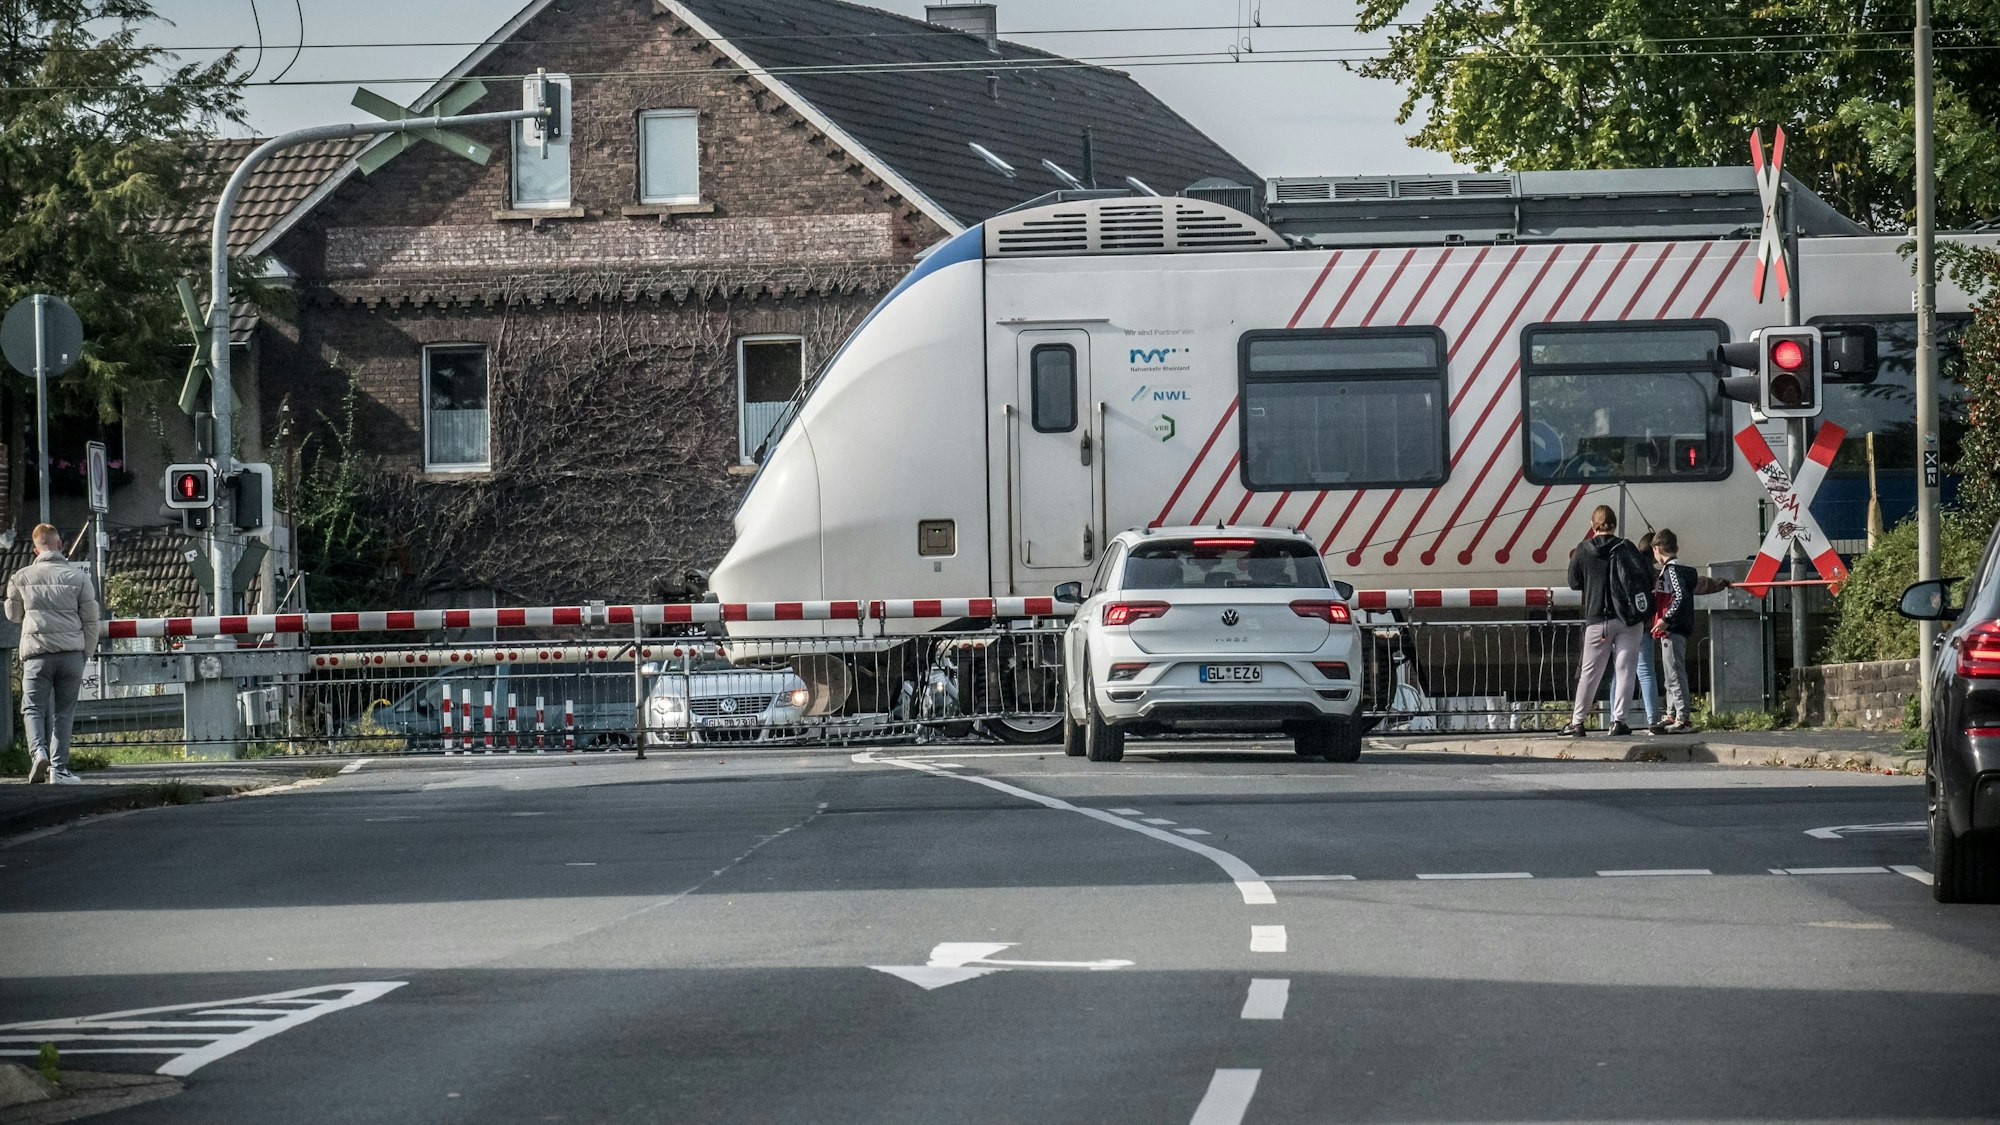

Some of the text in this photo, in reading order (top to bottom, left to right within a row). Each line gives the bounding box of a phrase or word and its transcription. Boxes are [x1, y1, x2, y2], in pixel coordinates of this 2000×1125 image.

[1833, 361, 1840, 370] 9
[1153, 390, 1190, 401] NWL
[195, 518, 202, 526] 5
[1207, 666, 1225, 680] GL
